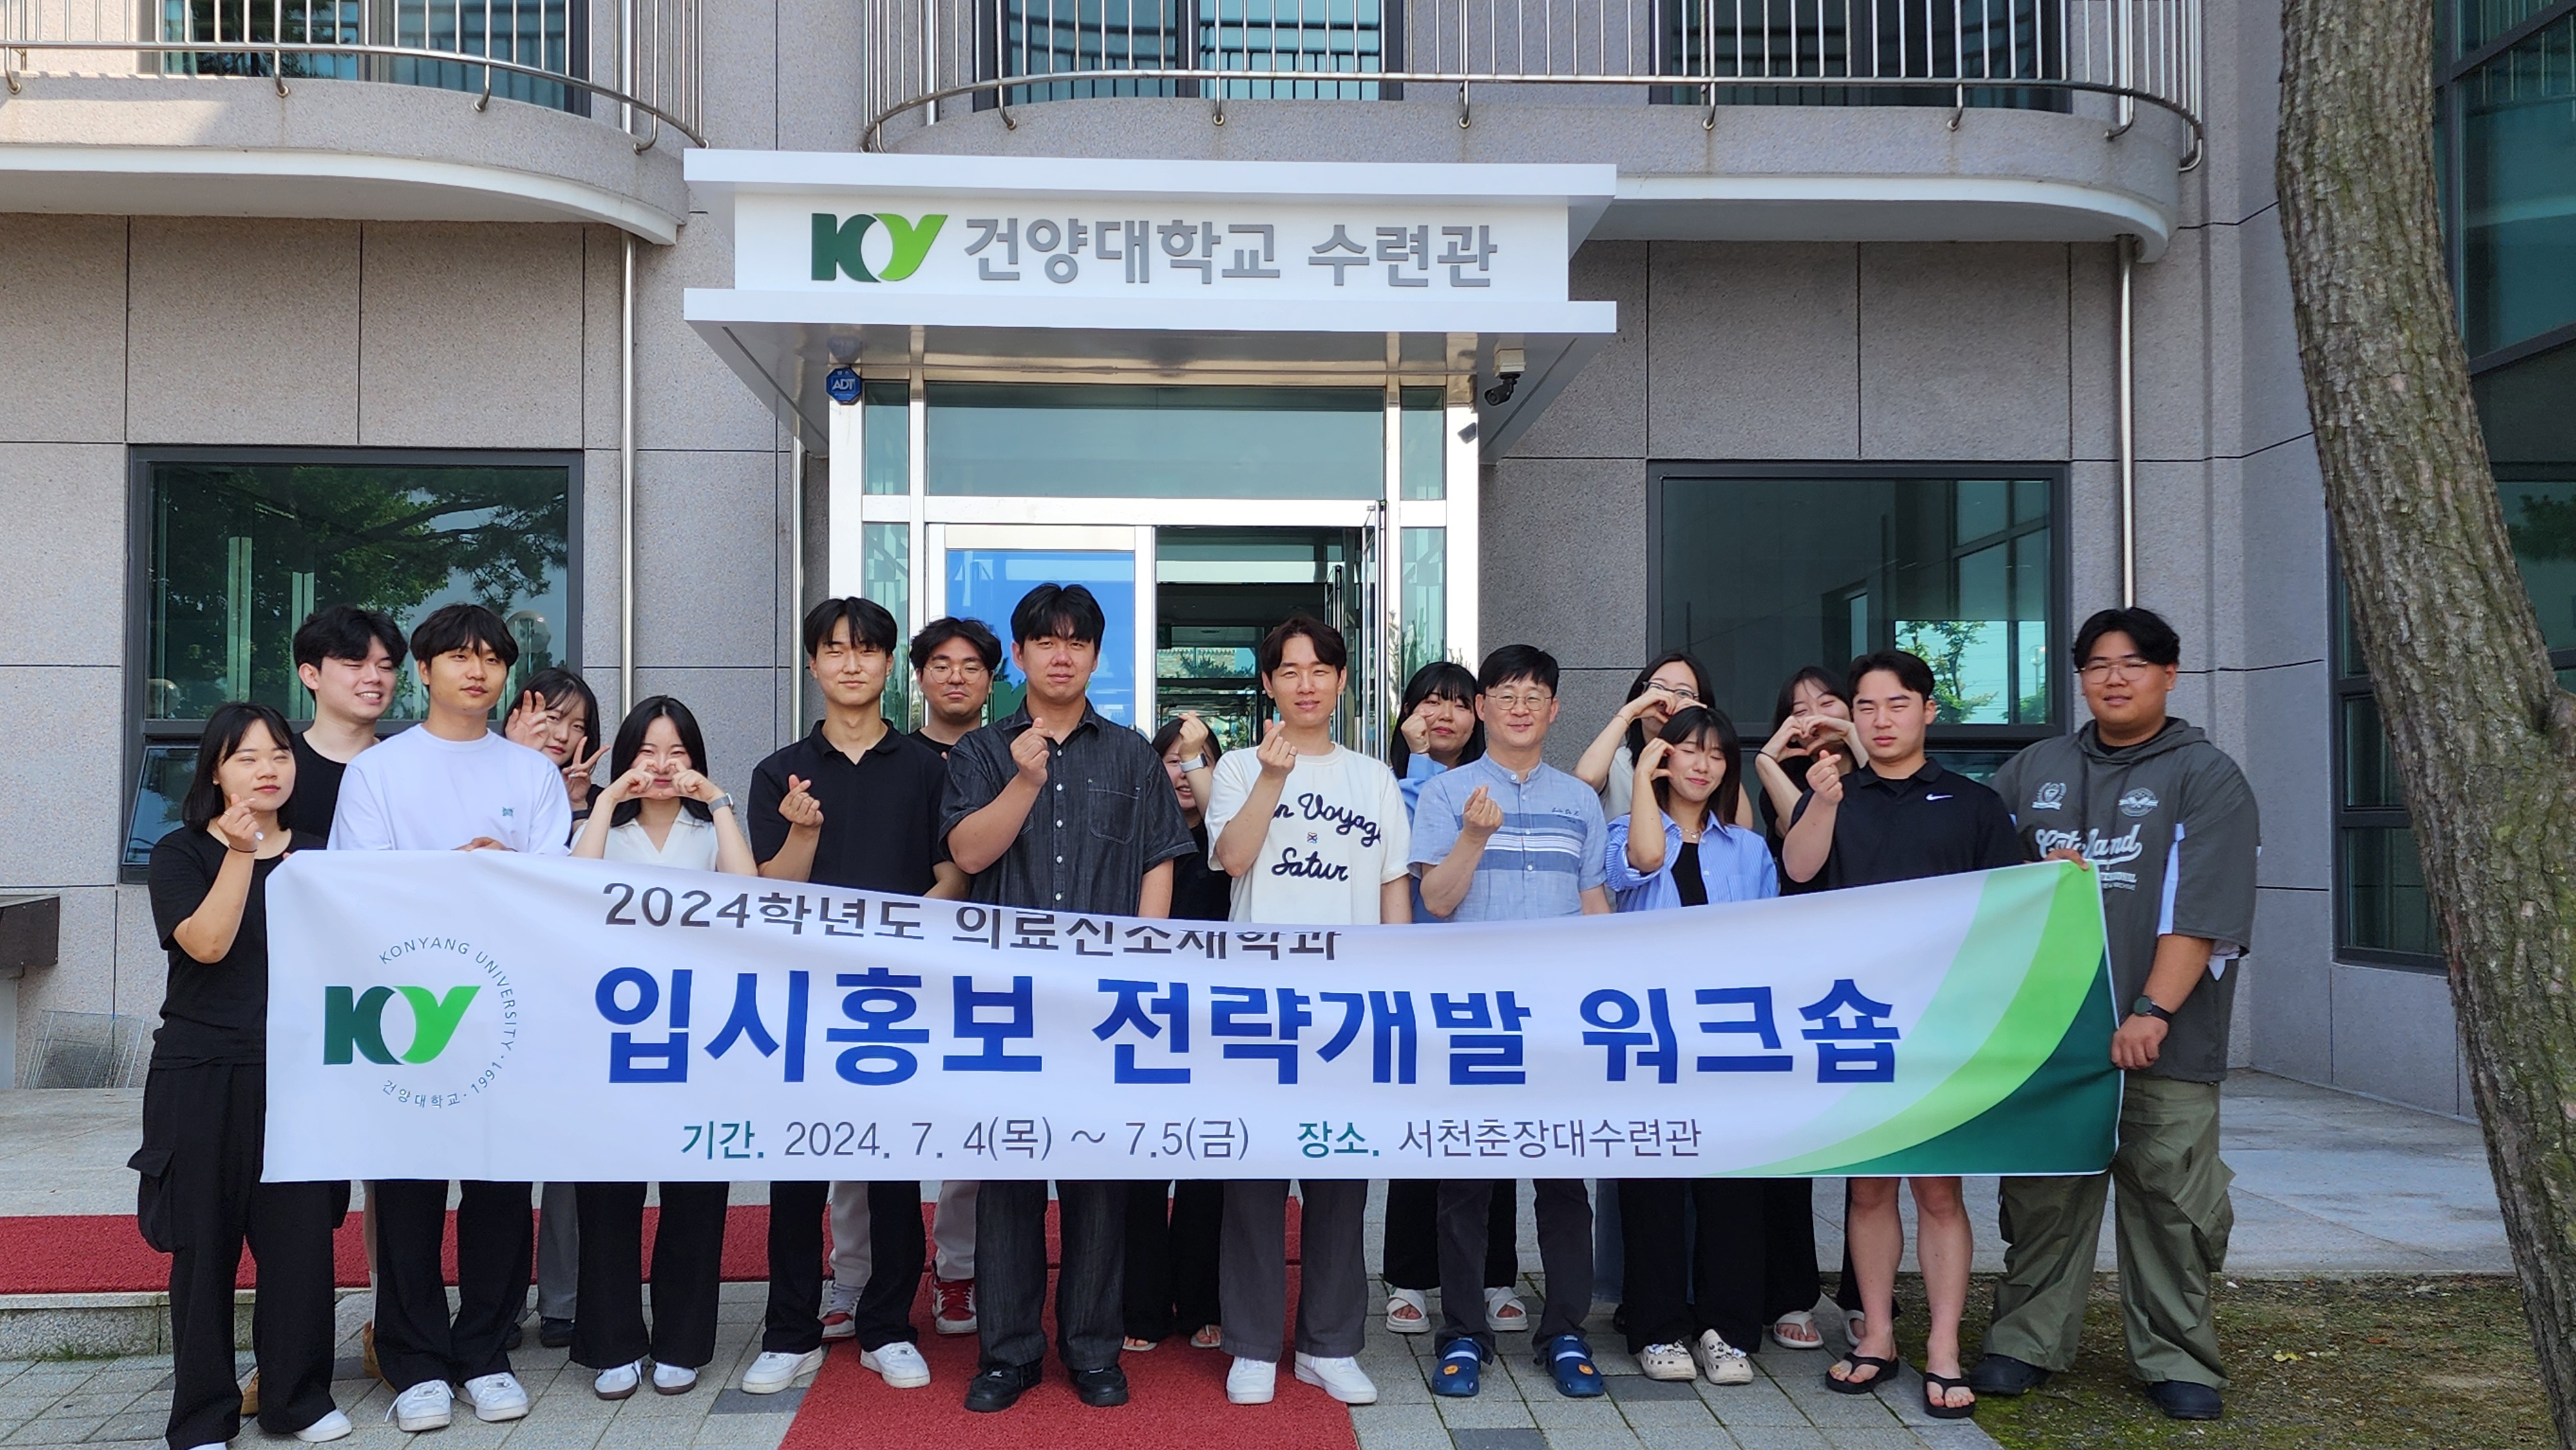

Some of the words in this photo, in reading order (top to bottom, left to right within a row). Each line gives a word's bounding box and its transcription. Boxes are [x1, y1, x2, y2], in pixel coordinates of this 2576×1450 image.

[965, 218, 1280, 285] 건양대학교
[1309, 224, 1498, 288] 수련관
[831, 378, 855, 390] ADT
[1271, 847, 1349, 882] Satur
[603, 883, 924, 940] 2024학년도
[379, 937, 470, 965] KONYANG
[475, 951, 517, 1051] UNIVERSITY
[595, 966, 1043, 1086] 입시홍보
[1092, 978, 1532, 1086] 전략개발
[1579, 978, 1901, 1084] 워크숍
[681, 1120, 764, 1160] 기간.
[784, 1121, 890, 1159] 2024.
[911, 1122, 943, 1159] 7.
[963, 1116, 1052, 1162] 4(목)
[1125, 1116, 1249, 1161] 7.5(금)
[1297, 1120, 1379, 1158] 장소.
[1398, 1118, 1702, 1158] 서천춘장대수련관
